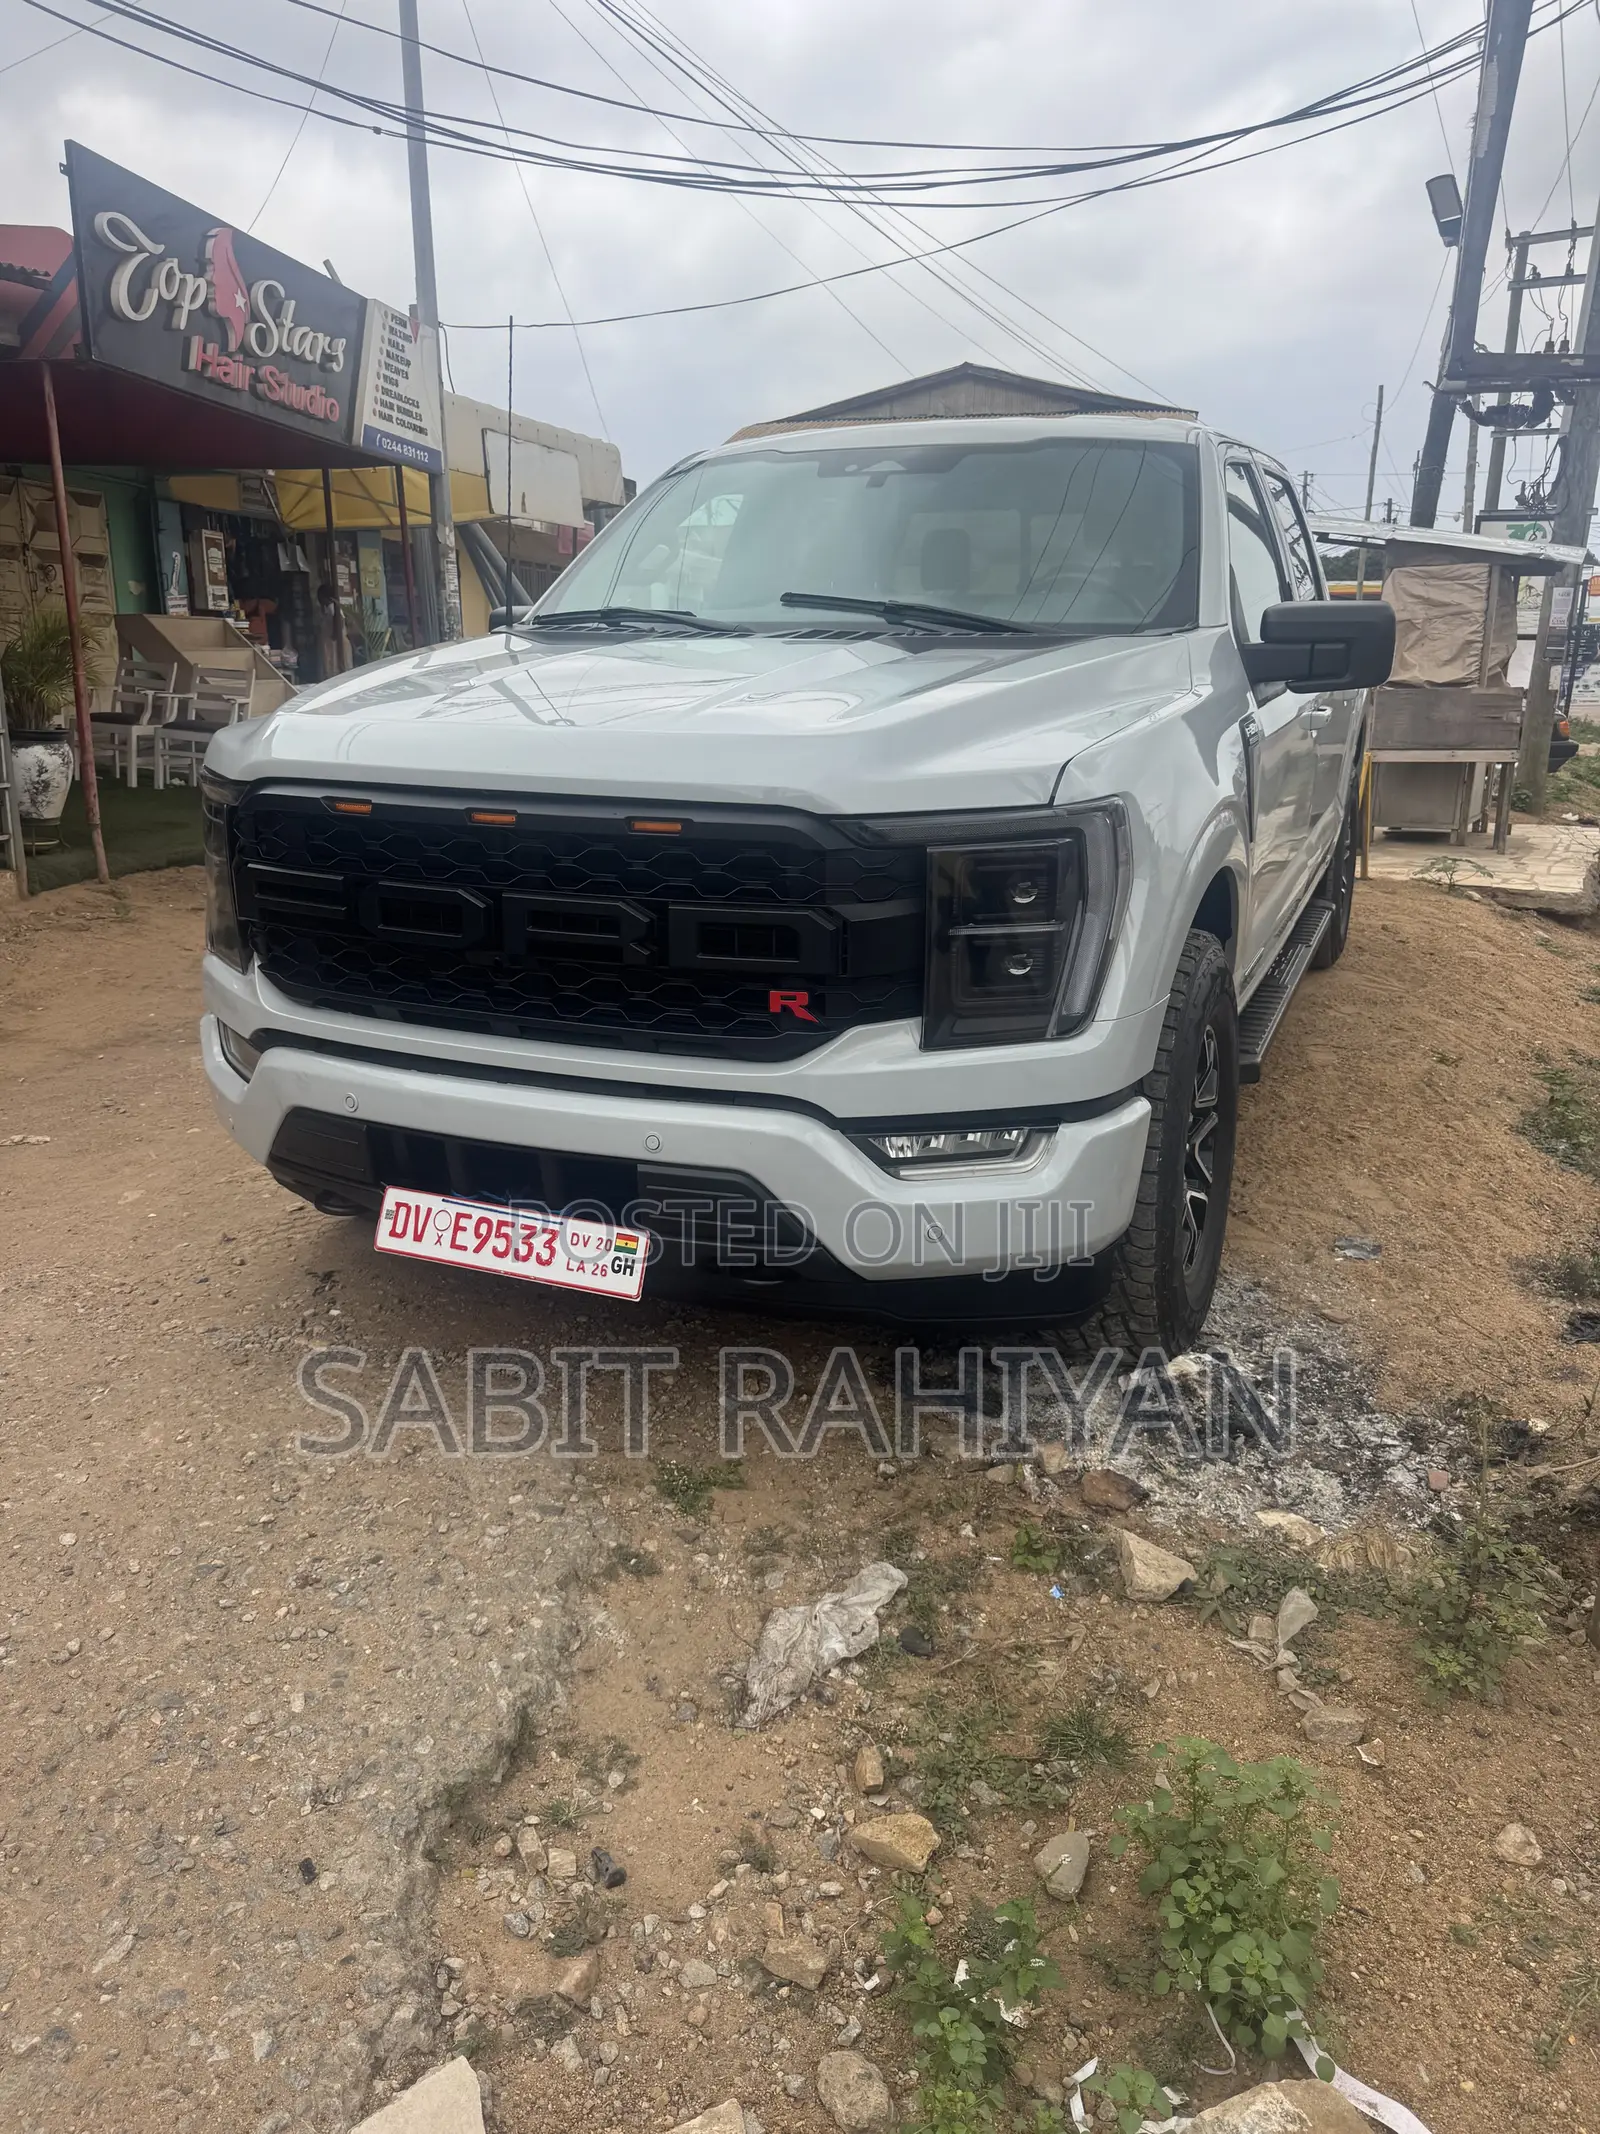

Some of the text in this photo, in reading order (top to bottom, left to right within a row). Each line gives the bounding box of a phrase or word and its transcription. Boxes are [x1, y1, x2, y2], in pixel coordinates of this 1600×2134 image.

[94, 211, 346, 371] Top Stars
[385, 348, 412, 369] MAKEUP
[190, 335, 340, 422] Hair Studio
[382, 373, 399, 388] WIGS
[379, 397, 396, 412] HAIR
[380, 385, 420, 409] DREADLOCKS
[377, 409, 429, 436] HAIR COLOURING
[381, 437, 402, 454] 0244
[236, 862, 842, 976] FORD
[769, 990, 820, 1023] R
[388, 1201, 433, 1243] DV
[449, 1211, 560, 1267] E9533
[570, 1231, 613, 1253] DV 20
[565, 1260, 608, 1278] LA 26
[610, 1254, 636, 1277] GH
